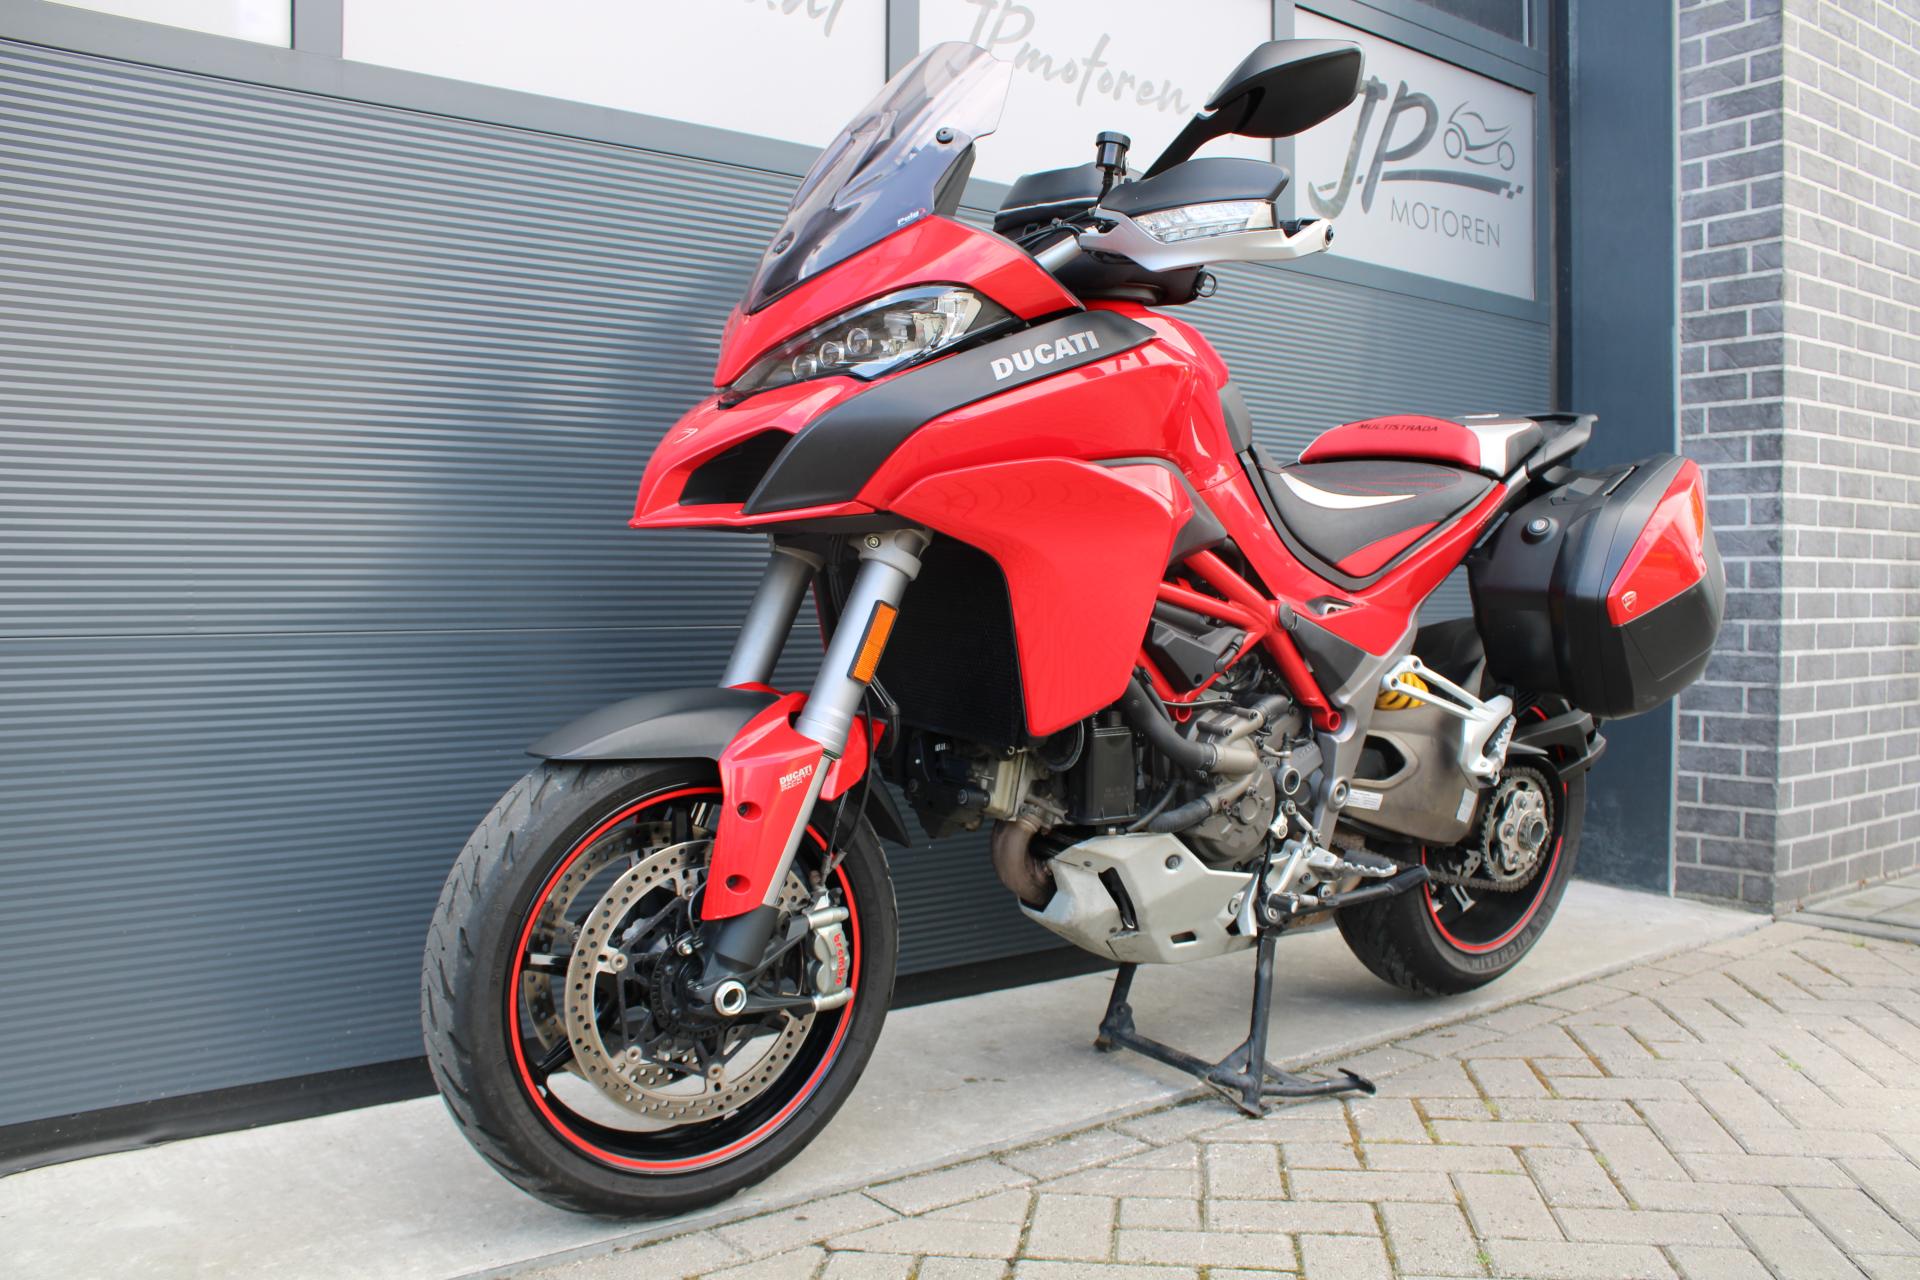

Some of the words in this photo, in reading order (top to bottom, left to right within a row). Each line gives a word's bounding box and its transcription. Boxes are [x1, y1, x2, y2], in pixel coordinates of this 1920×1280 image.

[1390, 197, 1500, 248] MOTOREN
[990, 330, 1100, 381] DUCATI
[1359, 423, 1439, 432] MULTISTRADA
[779, 764, 813, 785] DUCATI
